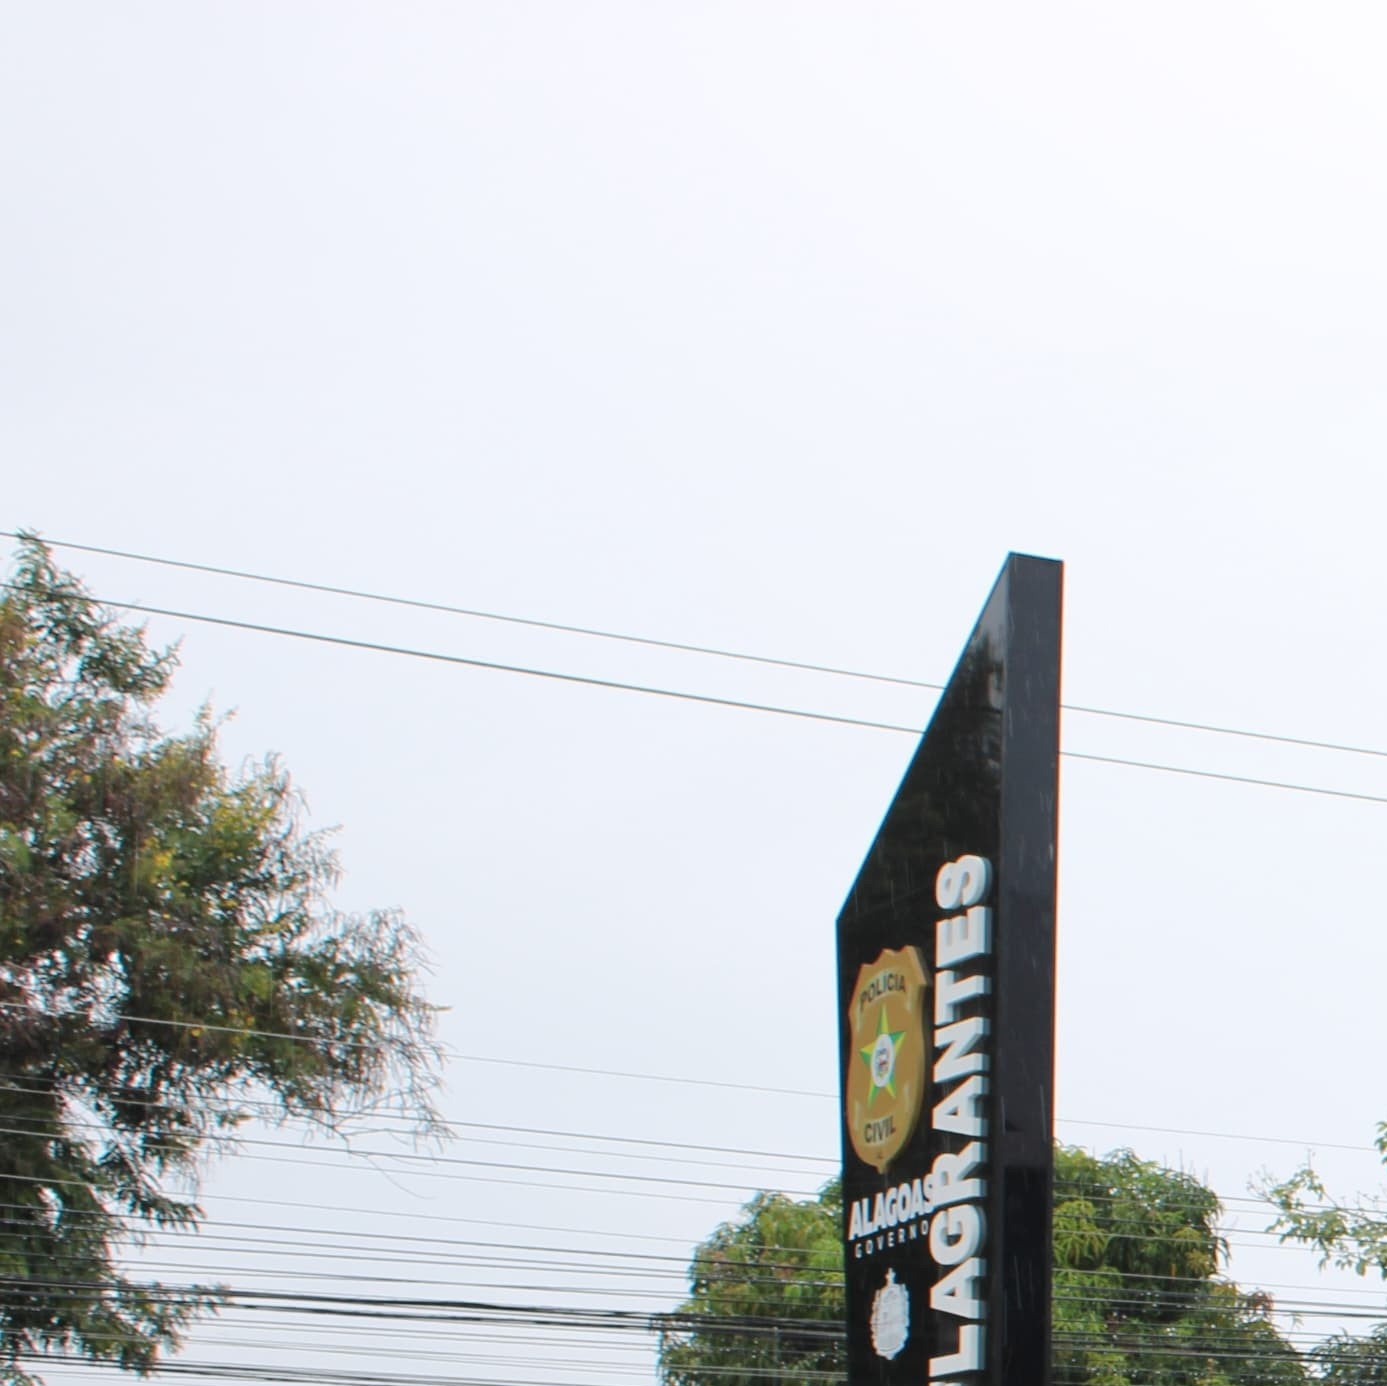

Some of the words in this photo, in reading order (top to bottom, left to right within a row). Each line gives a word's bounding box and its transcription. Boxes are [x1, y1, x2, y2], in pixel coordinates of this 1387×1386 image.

[863, 1115, 897, 1143] CIVIL
[848, 1172, 935, 1241] ALAGOAS
[855, 1219, 929, 1259] GOVERNO
